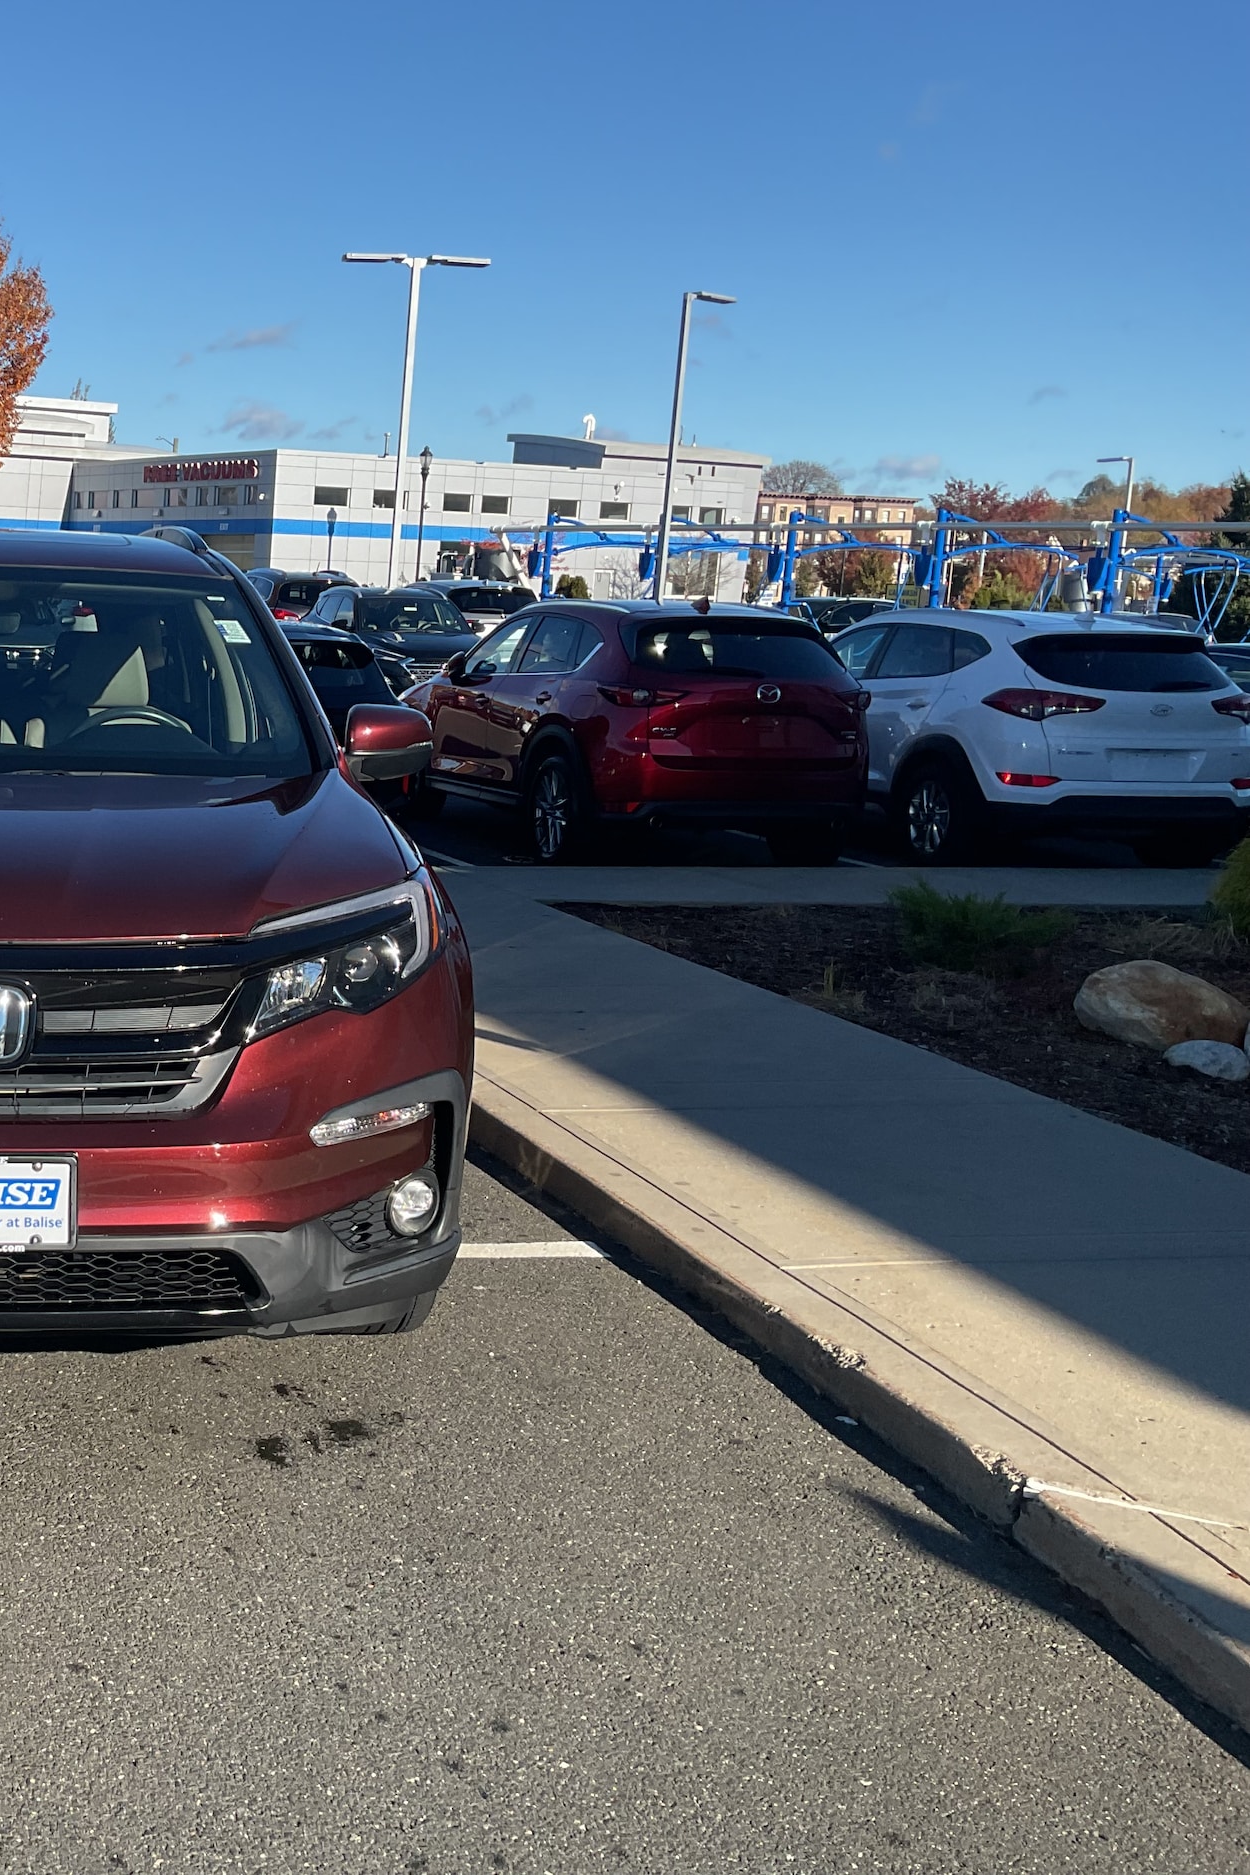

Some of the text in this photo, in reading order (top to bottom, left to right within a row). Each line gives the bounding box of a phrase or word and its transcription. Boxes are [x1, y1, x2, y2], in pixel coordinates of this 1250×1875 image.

[143, 459, 259, 483] FREE VACUUMS
[7, 1218, 20, 1228] at
[25, 1216, 62, 1228] Balise
